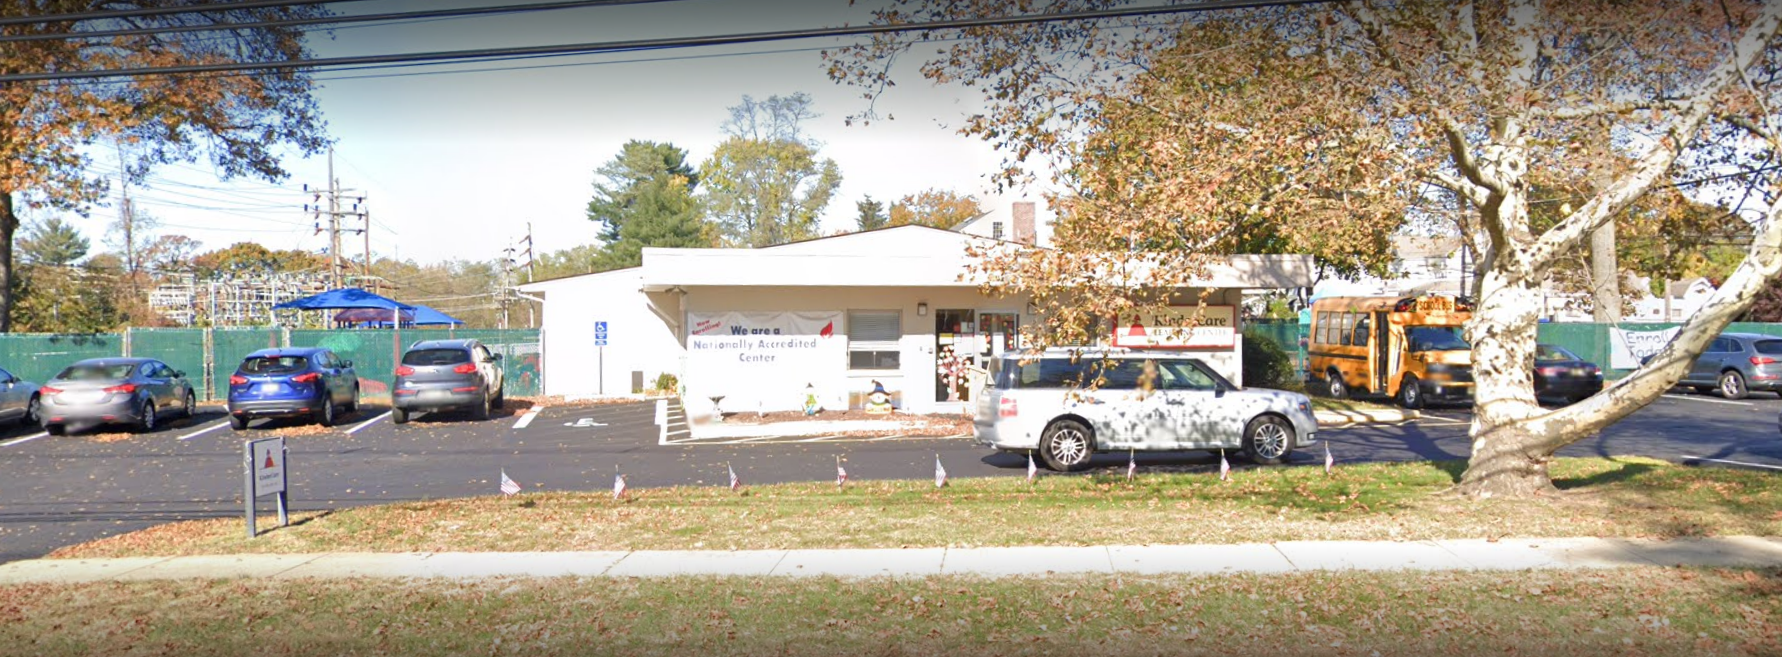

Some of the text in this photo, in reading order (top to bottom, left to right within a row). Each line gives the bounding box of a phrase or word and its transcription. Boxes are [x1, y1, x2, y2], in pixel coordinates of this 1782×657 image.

[1418, 301, 1453, 311] SCHOOL BUS
[691, 321, 722, 336] Enrolling!
[696, 319, 710, 328] Now
[730, 325, 781, 336] We are a
[1626, 331, 1669, 344] Enroll
[693, 338, 817, 351] Nationally Accredited
[739, 352, 776, 363] Center
